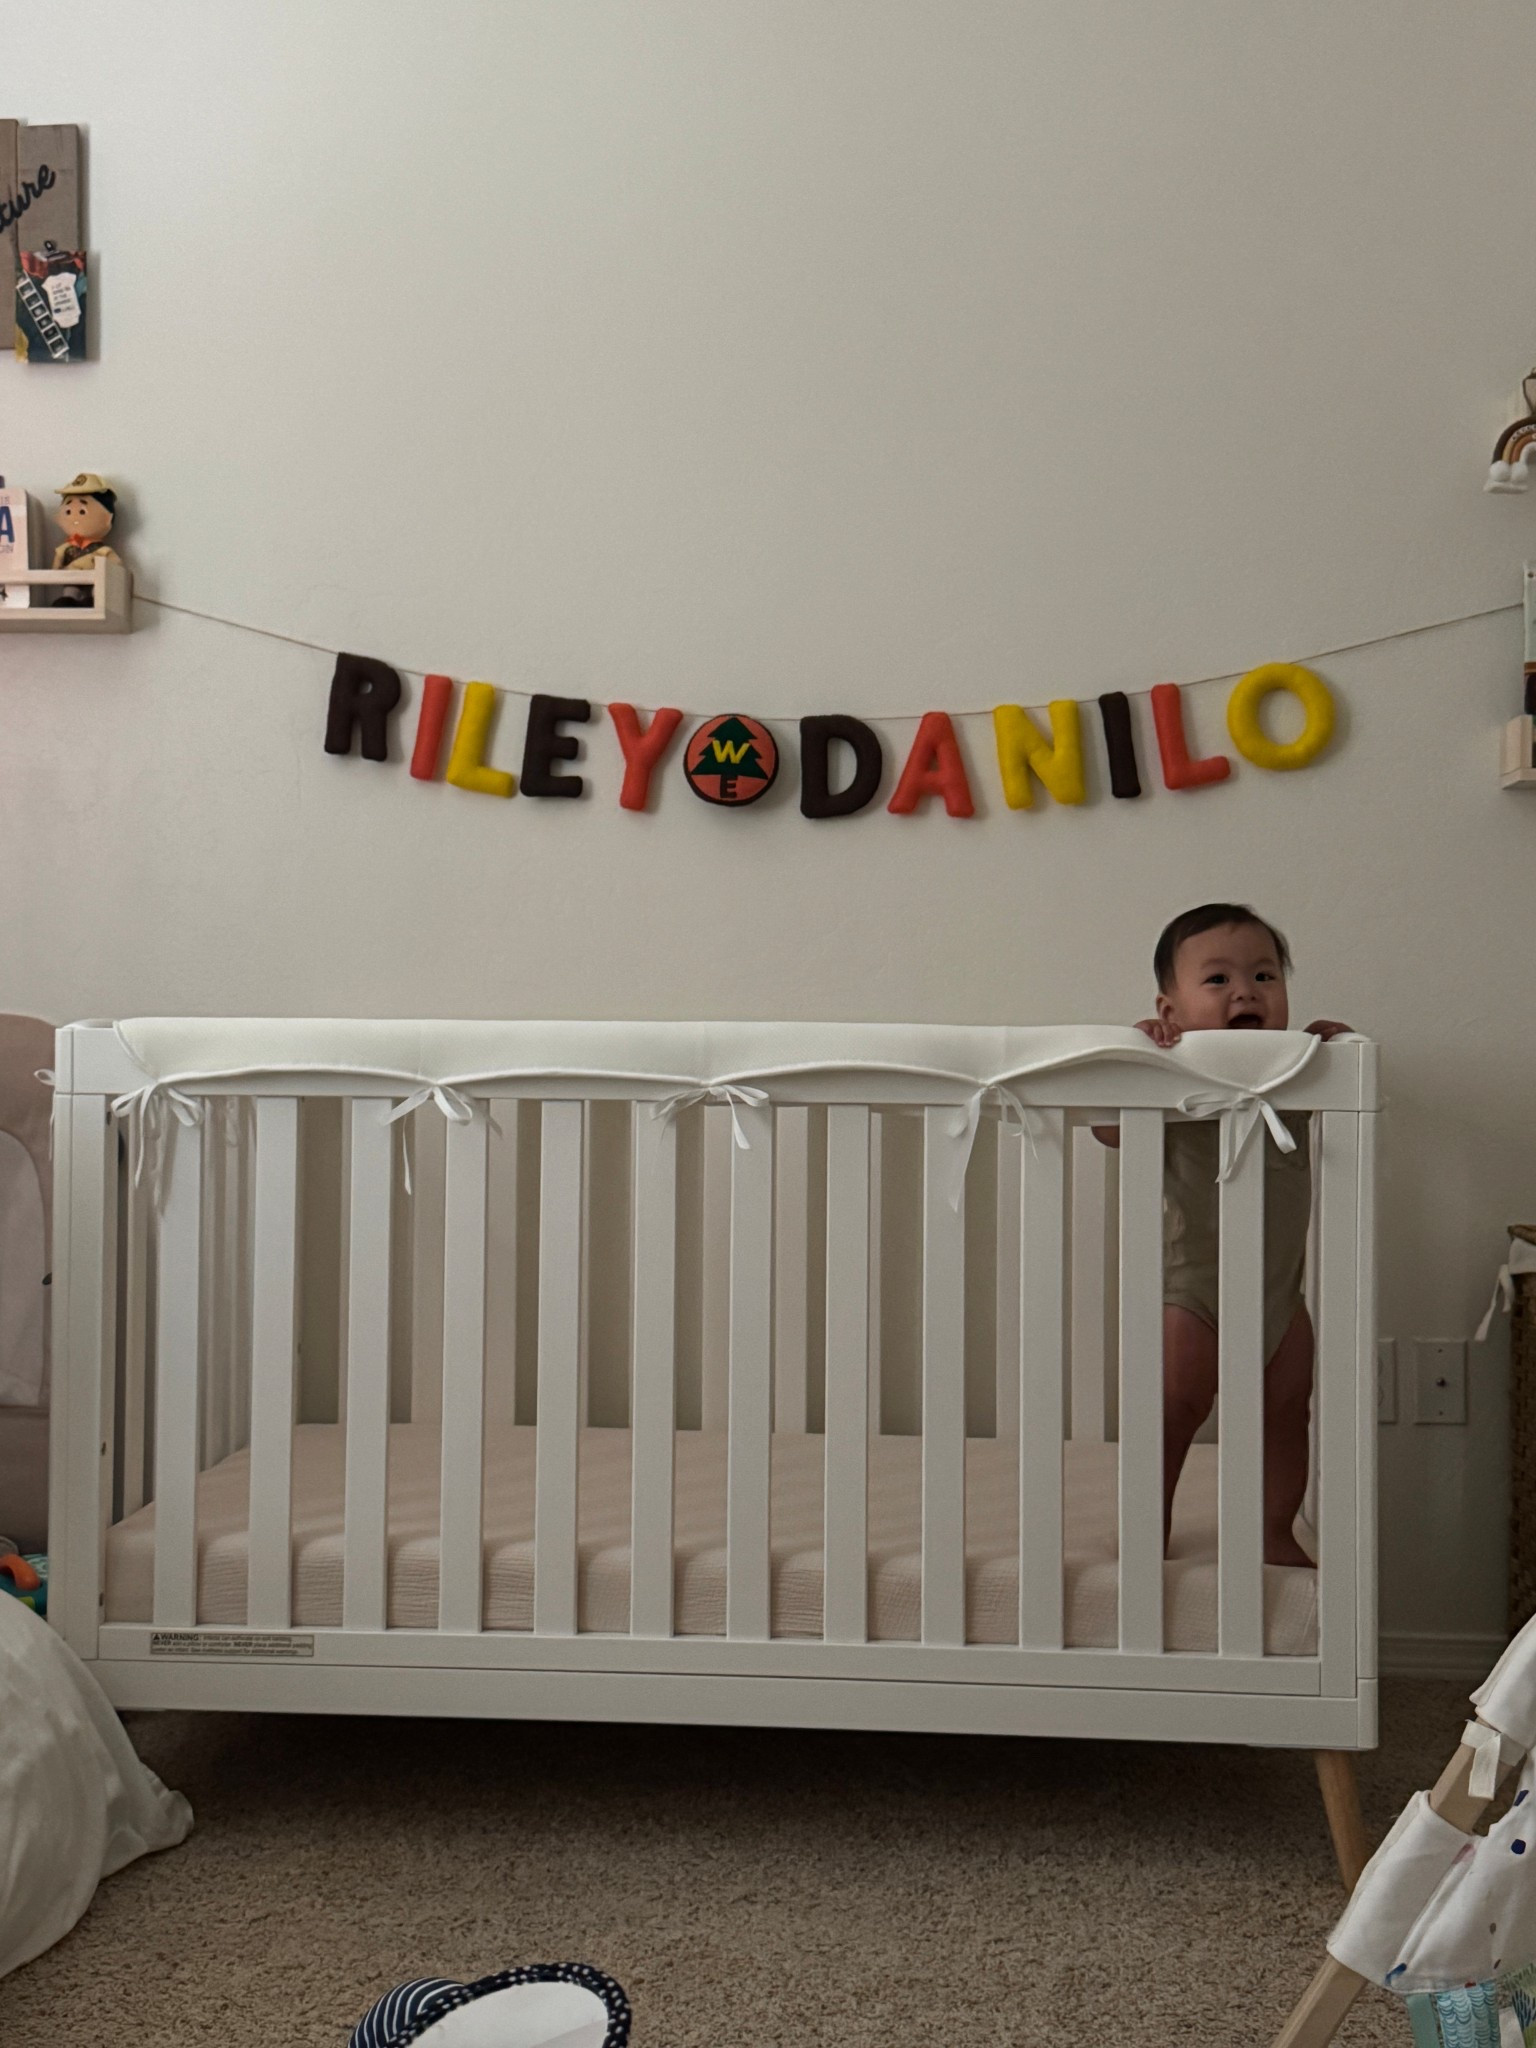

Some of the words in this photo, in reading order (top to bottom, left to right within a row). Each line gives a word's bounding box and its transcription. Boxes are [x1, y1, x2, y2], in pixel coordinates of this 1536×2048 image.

[324, 652, 684, 811] RILEY
[800, 662, 1336, 820] DANILO
[712, 739, 750, 764] W
